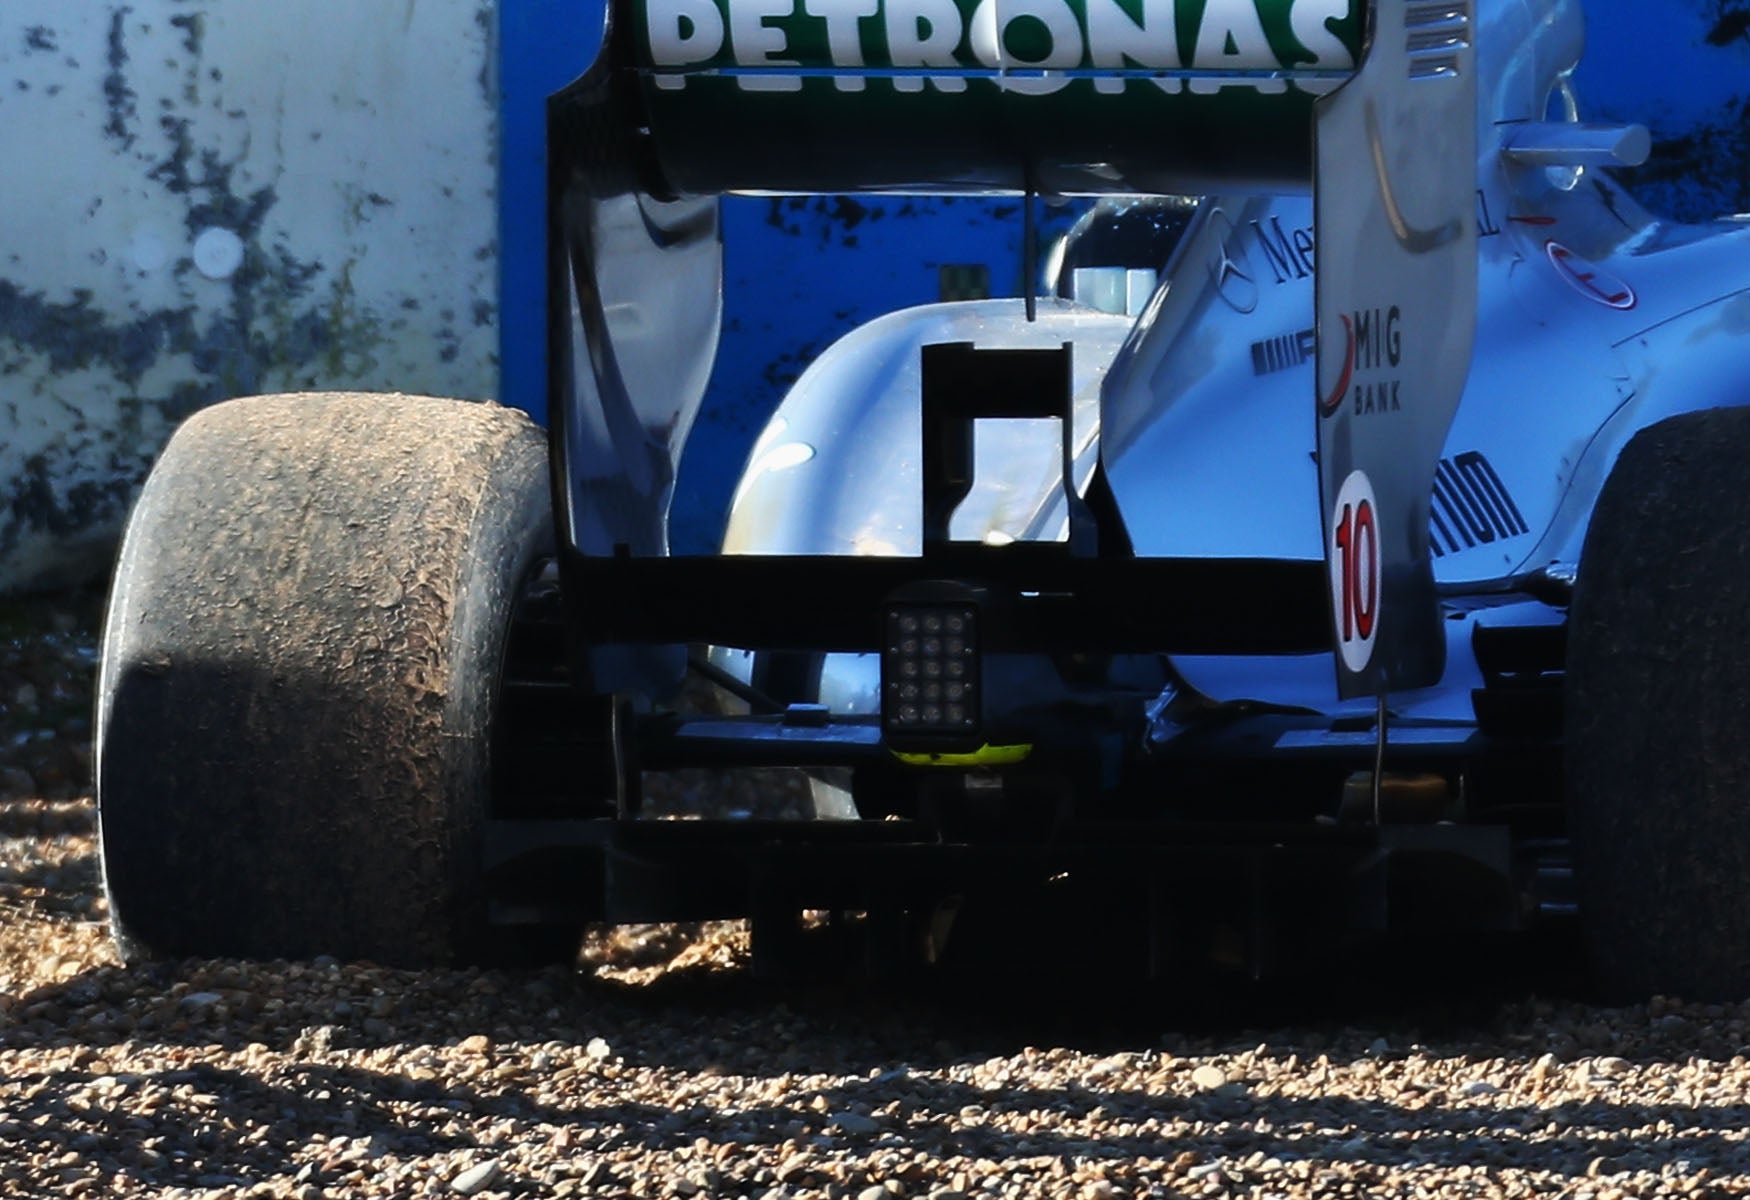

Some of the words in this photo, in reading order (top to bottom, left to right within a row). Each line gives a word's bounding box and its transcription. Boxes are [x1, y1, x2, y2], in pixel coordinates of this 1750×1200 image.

[1353, 304, 1401, 371] MIG
[1354, 380, 1401, 417] BANK
[1336, 498, 1378, 642] 10
